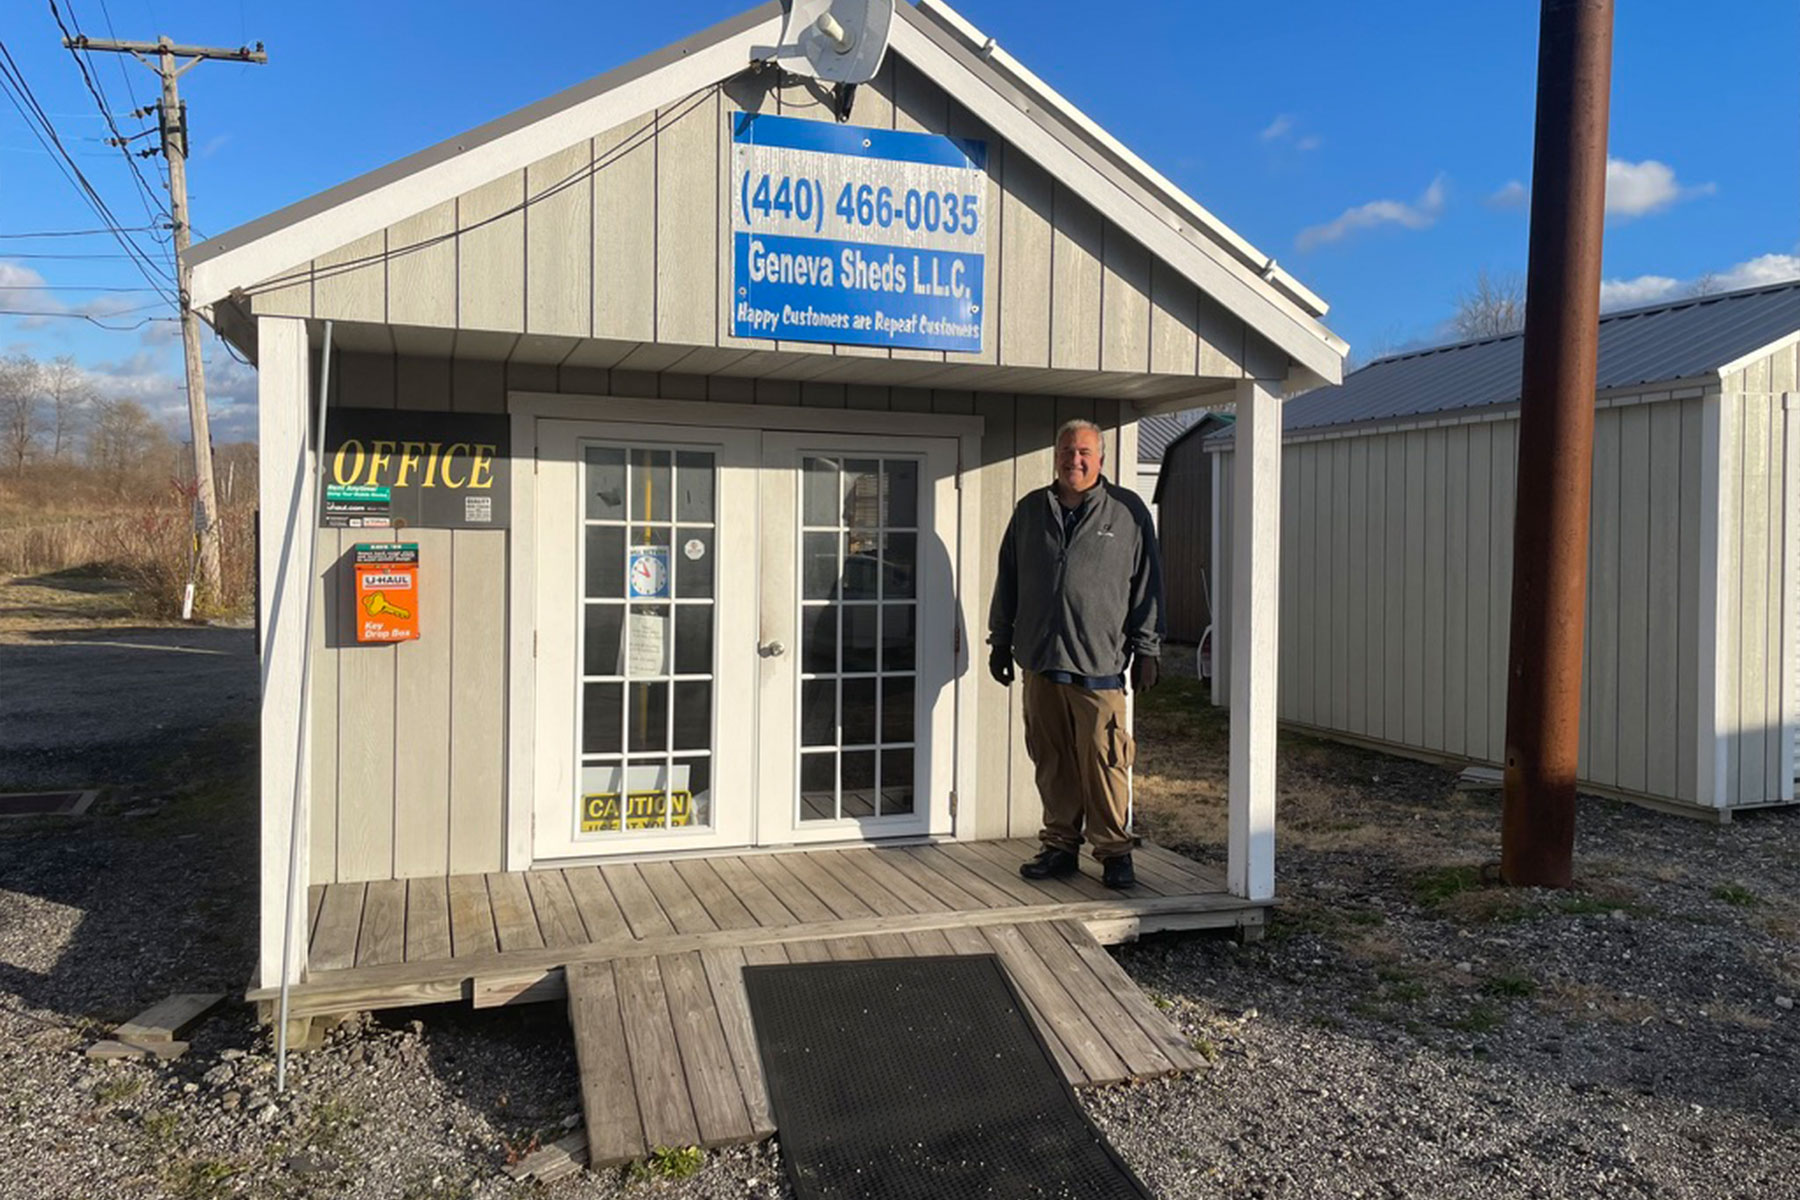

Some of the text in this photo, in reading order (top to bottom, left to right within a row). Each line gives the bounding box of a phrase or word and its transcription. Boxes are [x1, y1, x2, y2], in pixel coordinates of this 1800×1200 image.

[741, 169, 978, 235] (440) 466-0035
[749, 240, 971, 299] Geneva Sheds L.L.C.
[737, 302, 980, 339] Happy Customers are Repeat Customers
[333, 439, 496, 489] OFFICE
[365, 621, 384, 631] Key
[365, 629, 410, 639] Drop Box
[589, 796, 685, 818] CAUTION
